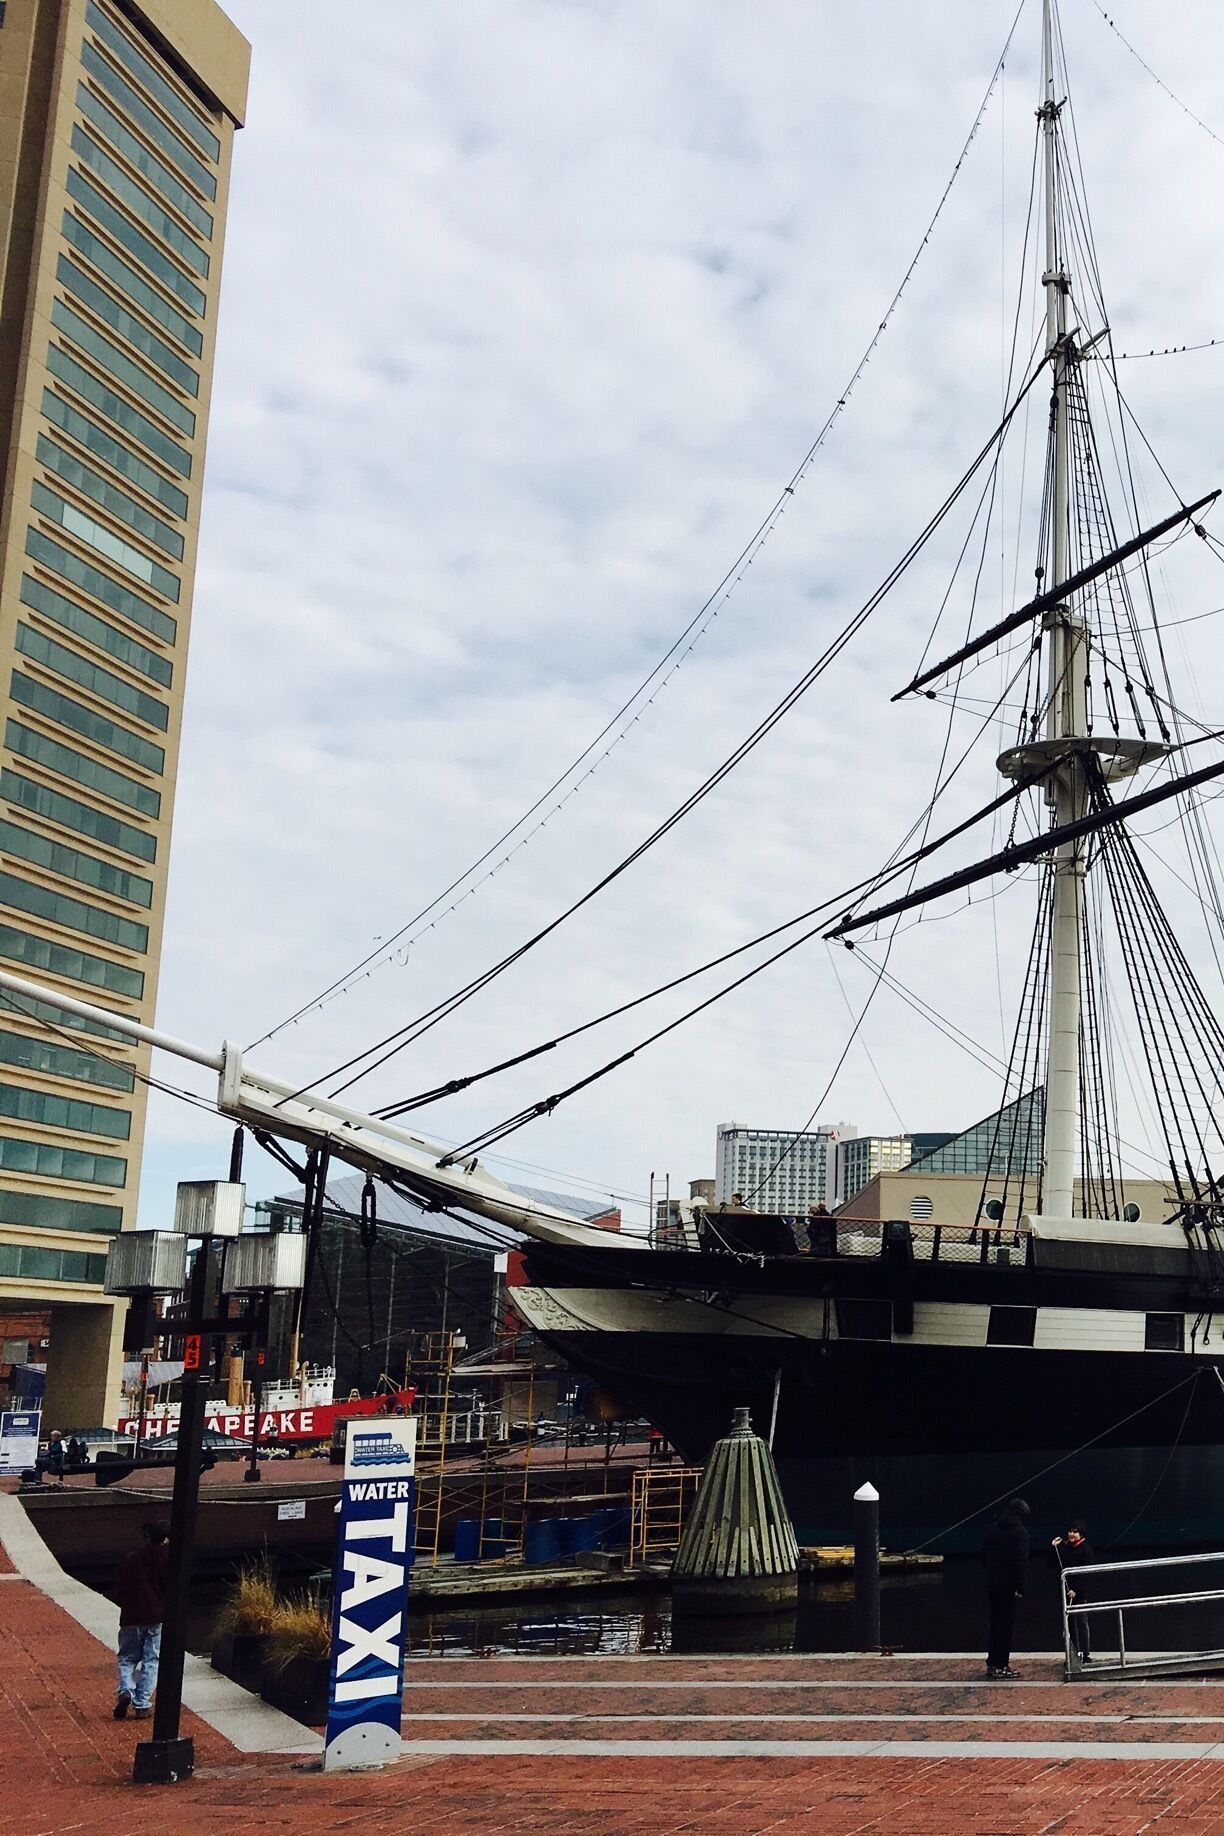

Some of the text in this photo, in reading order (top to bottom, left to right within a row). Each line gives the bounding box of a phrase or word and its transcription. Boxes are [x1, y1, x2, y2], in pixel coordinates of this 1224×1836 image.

[125, 1411, 314, 1440] CHEAPEAKE
[348, 1481, 409, 1502] WATER
[334, 1502, 409, 1703] TAXI
